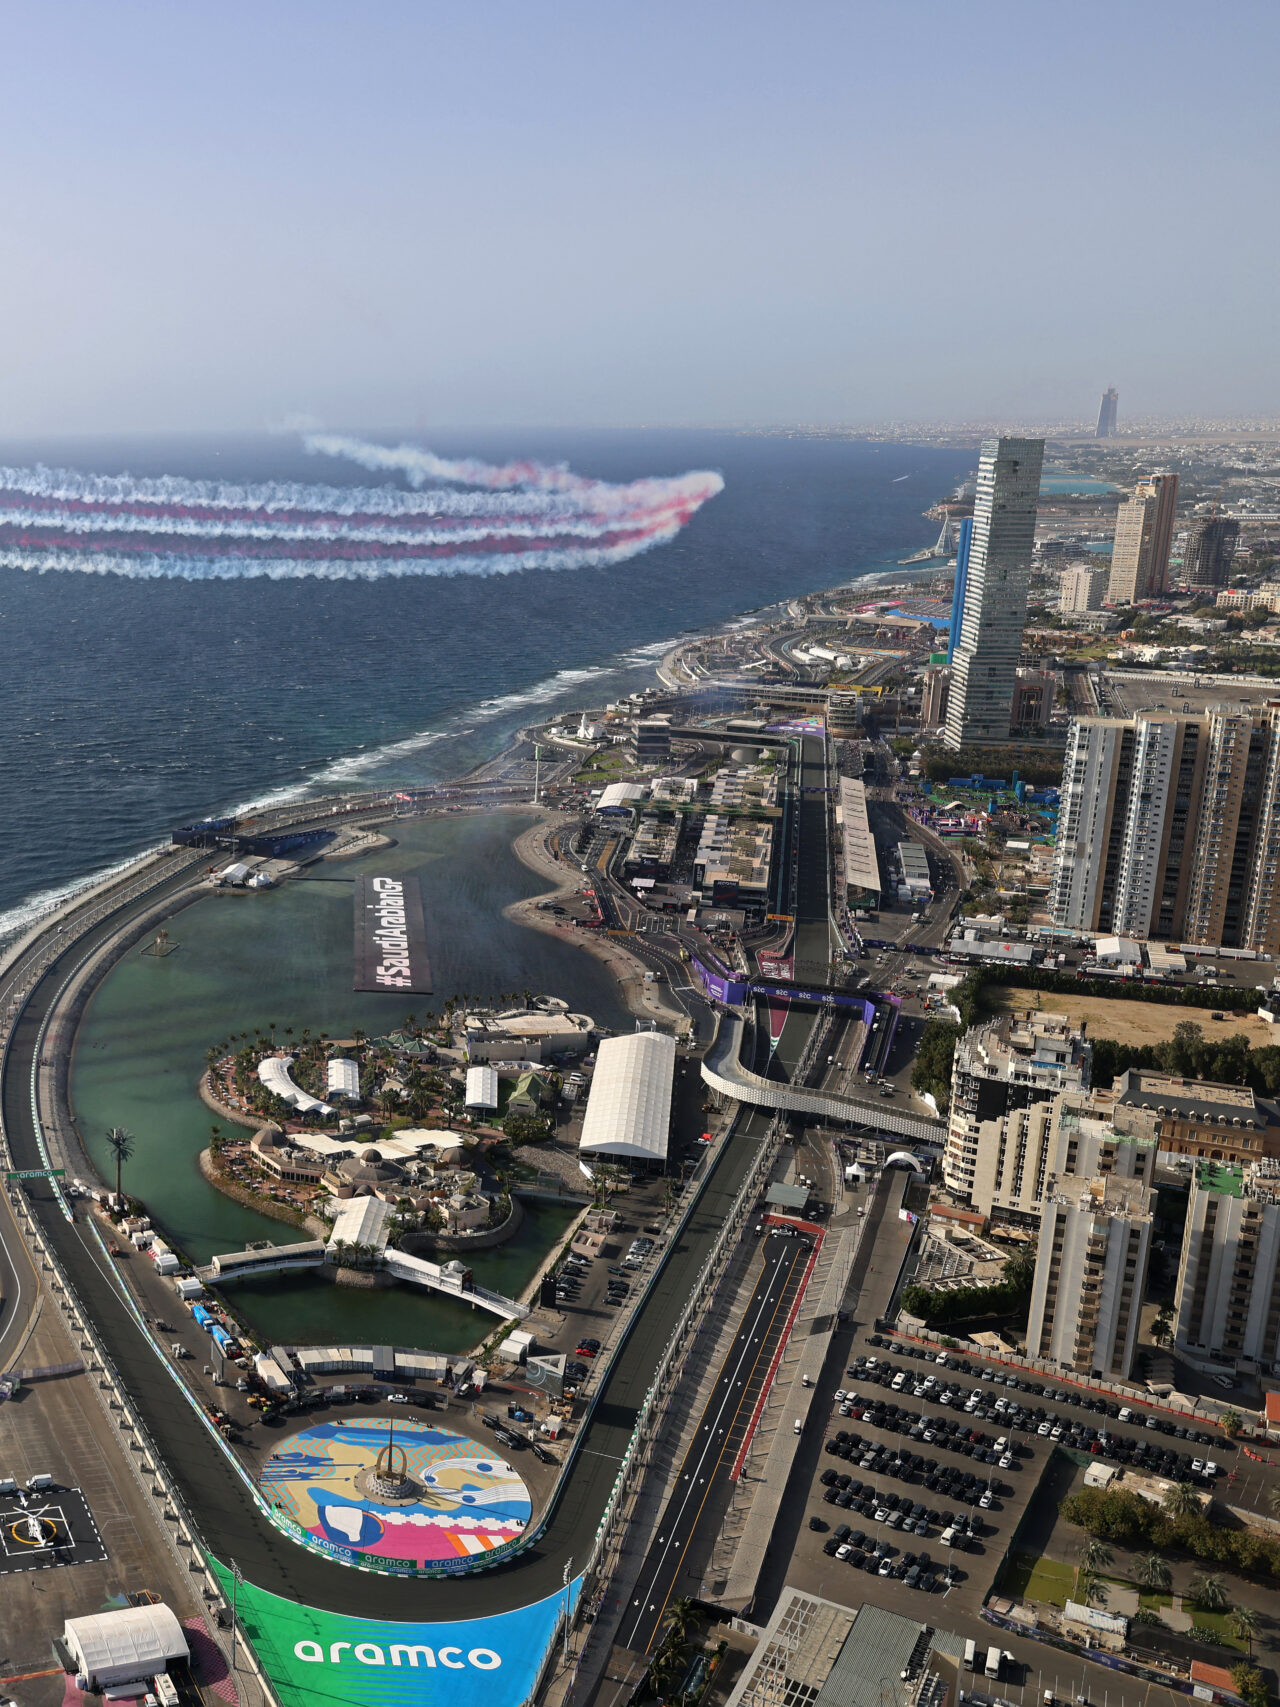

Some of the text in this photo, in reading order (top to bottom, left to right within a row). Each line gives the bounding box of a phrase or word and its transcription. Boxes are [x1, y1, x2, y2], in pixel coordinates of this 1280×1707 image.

[367, 877, 412, 987] #SaudiArabianGP
[20, 1171, 52, 1179] aramco
[274, 1509, 302, 1535] aramco
[312, 1535, 352, 1557] aramco
[484, 1540, 517, 1559] aramco
[365, 1554, 410, 1568] aramco
[431, 1556, 474, 1568] aramco
[293, 1640, 503, 1671] aramco
